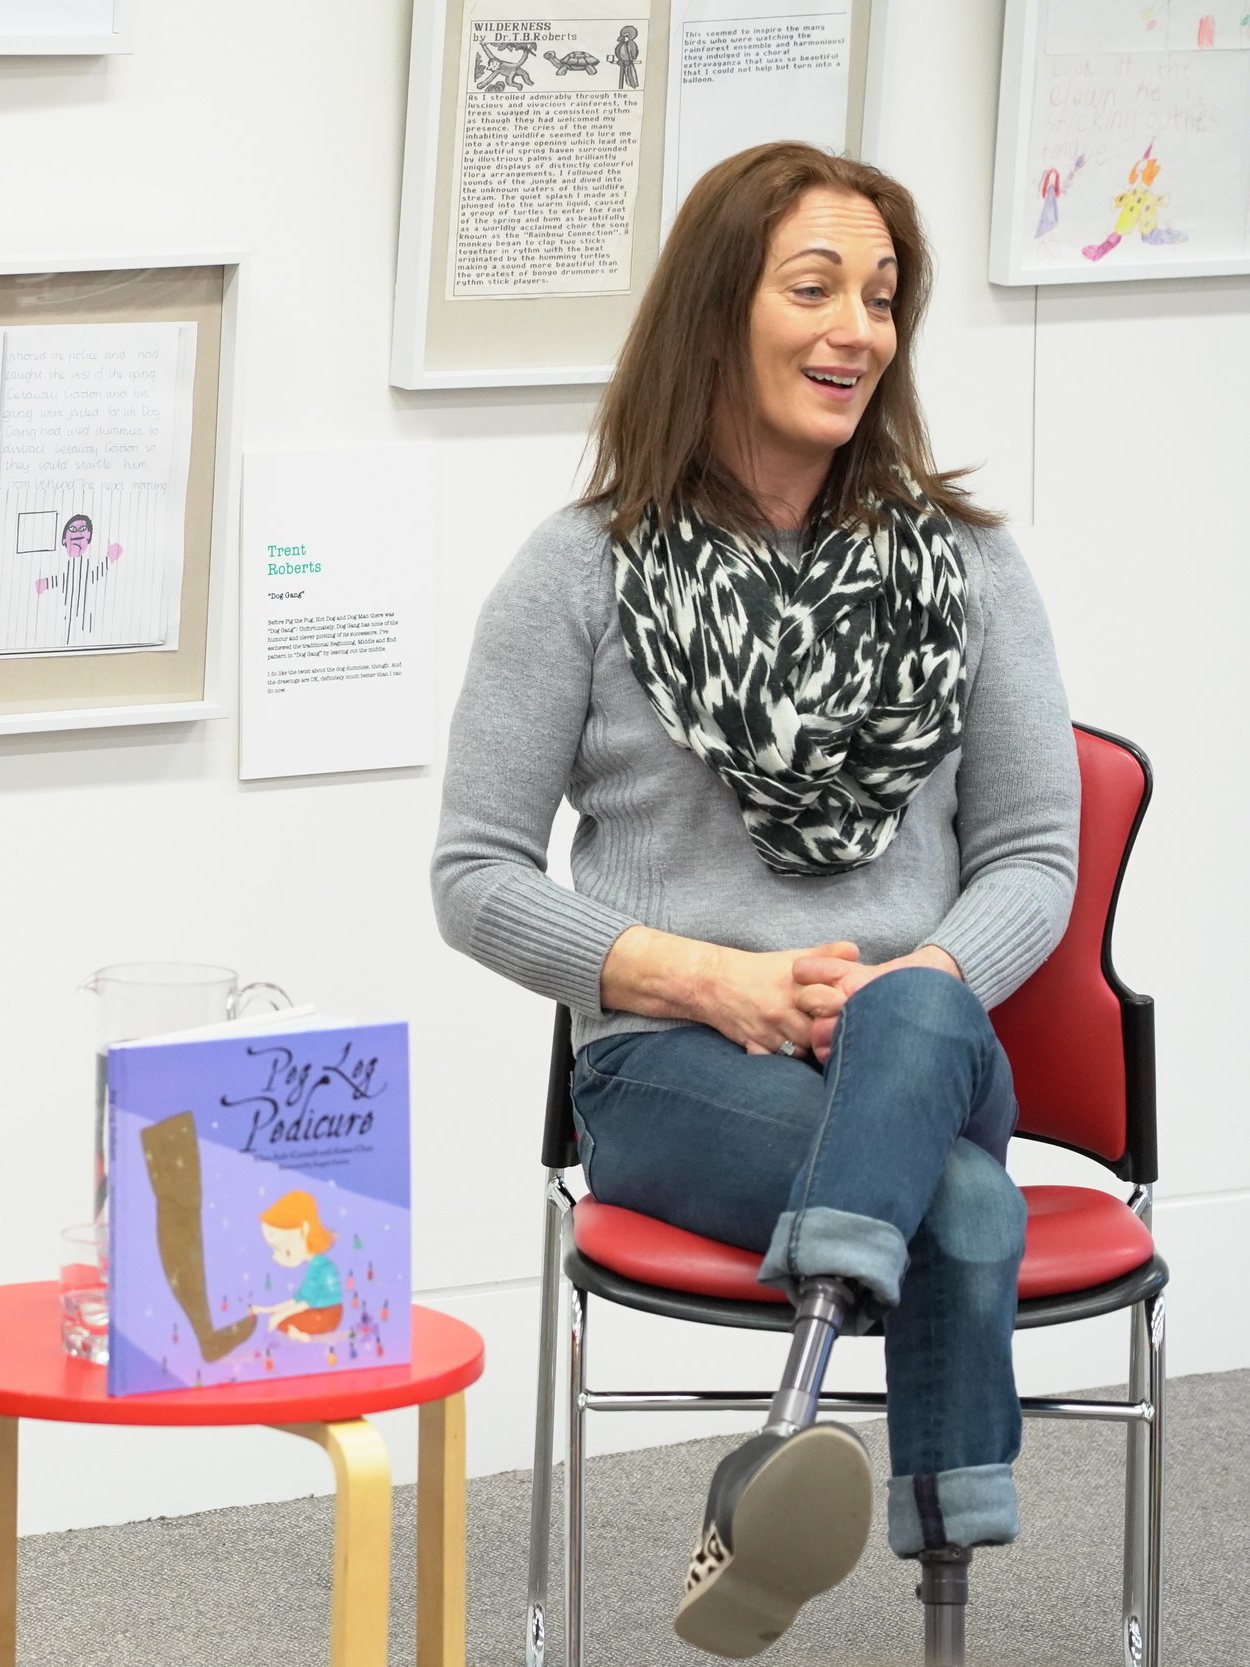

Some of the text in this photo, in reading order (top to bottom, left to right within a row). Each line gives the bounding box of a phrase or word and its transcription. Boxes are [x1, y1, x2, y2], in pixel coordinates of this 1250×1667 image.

[474, 22, 551, 31] WILDERNESS
[706, 28, 738, 36] seemed
[753, 26, 782, 35] inspire
[473, 32, 577, 42] by Dr.T.B.Roberts
[684, 38, 706, 46] birds
[756, 34, 794, 42] watching
[684, 44, 730, 53] rainforest
[733, 42, 772, 50] ensemble
[706, 51, 740, 60] indulged
[763, 48, 790, 56] choral
[683, 60, 741, 68] extravaganza
[800, 53, 839, 61] beautiful
[683, 68, 701, 76] that
[712, 66, 734, 74] could
[755, 64, 772, 73] help
[529, 93, 572, 101] admirably
[576, 92, 610, 101] through
[570, 100, 620, 108] rainforest,
[497, 109, 530, 117] swayed
[603, 107, 630, 115] rythm
[481, 116, 511, 125] though
[515, 116, 534, 124] they
[518, 147, 545, 155] spring
[578, 145, 628, 153] surrounded
[490, 170, 555, 178] arrangements.
[458, 254, 503, 263] originated
[507, 254, 517, 262] by
[539, 253, 577, 261] humming
[457, 263, 488, 271] making
[556, 260, 595, 268] beautiful
[476, 270, 515, 279] greatest
[532, 269, 558, 277] bongo
[456, 279, 484, 287] rythm
[513, 278, 549, 286] players.
[268, 544, 306, 557] Trent
[268, 562, 322, 576] Roberts
[285, 591, 305, 599] Gang"
[247, 1041, 388, 1107] Peg Leg
[220, 1075, 374, 1153] Pedicure
